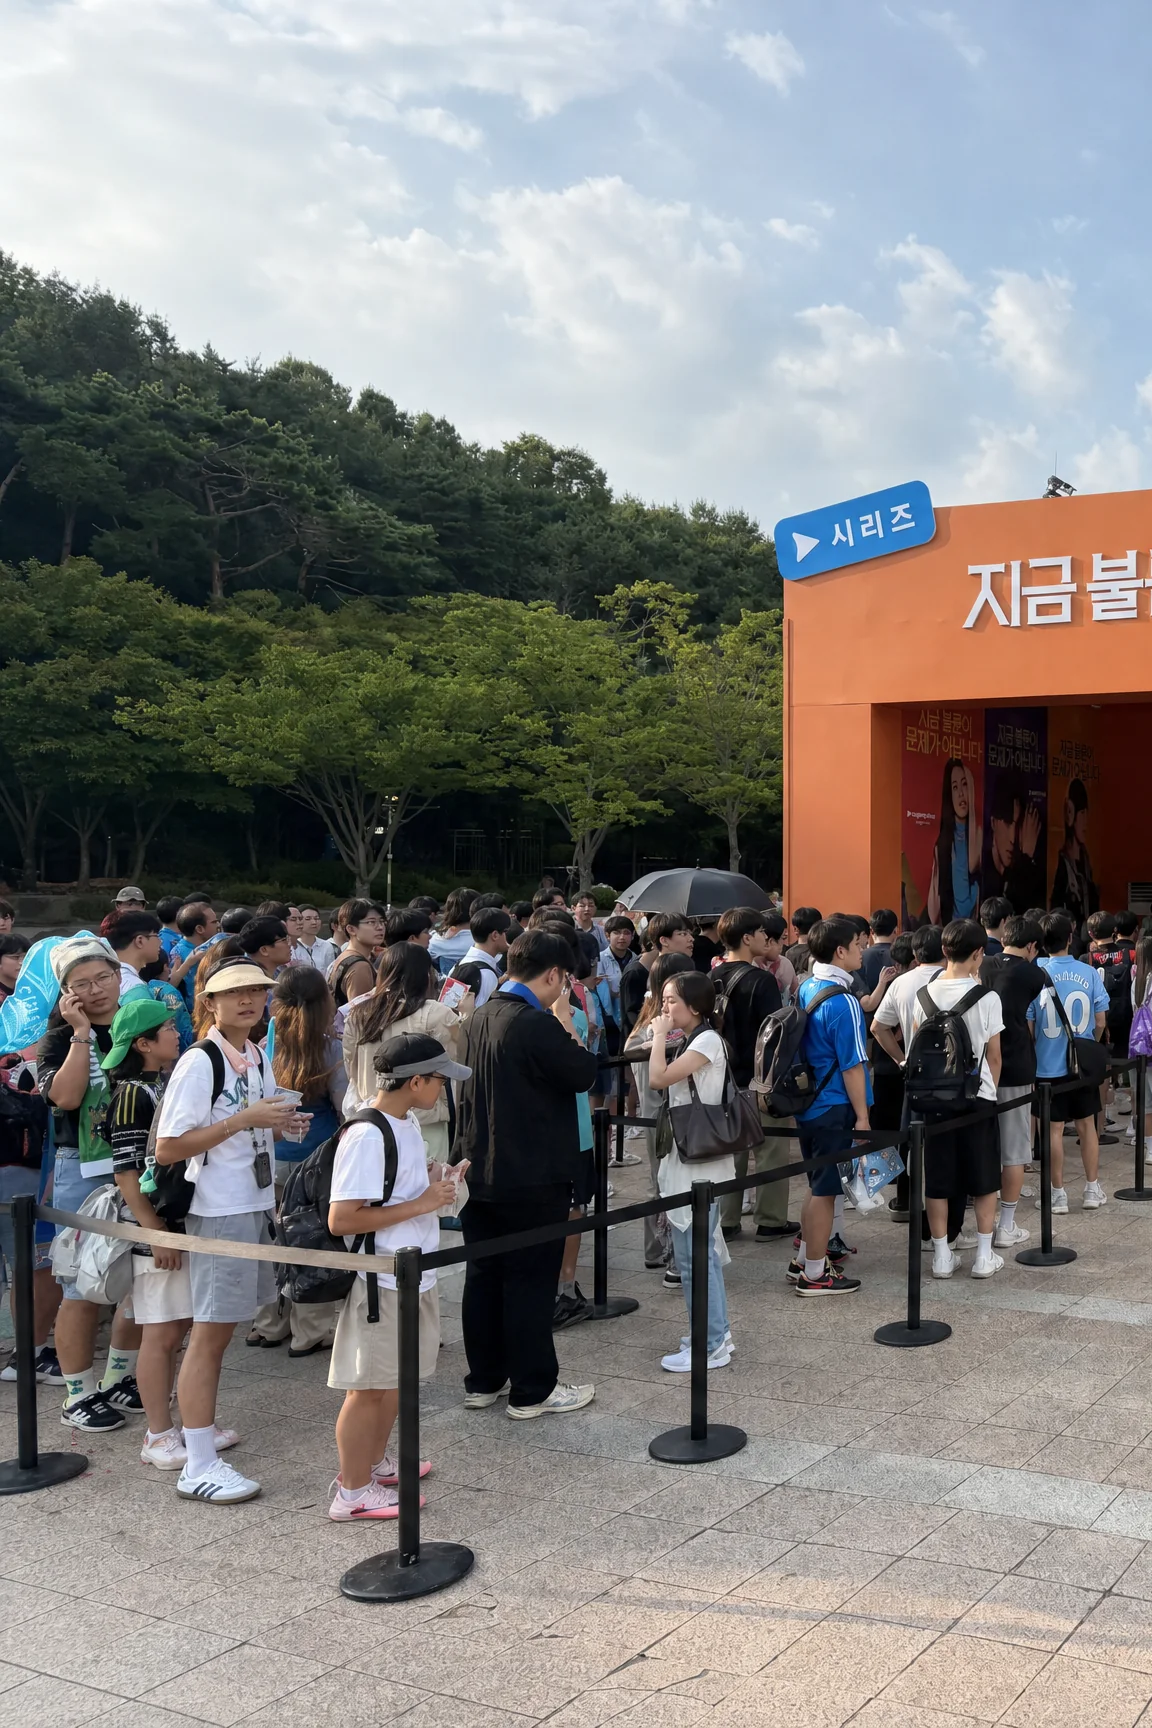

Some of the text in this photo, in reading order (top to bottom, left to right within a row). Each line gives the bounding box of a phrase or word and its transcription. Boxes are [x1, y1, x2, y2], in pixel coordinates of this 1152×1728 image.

[831, 503, 916, 547] 시리즈
[962, 555, 1077, 628] 지금
[906, 726, 982, 763] 문제가 아닙니다
[1040, 990, 1090, 1038] 10
